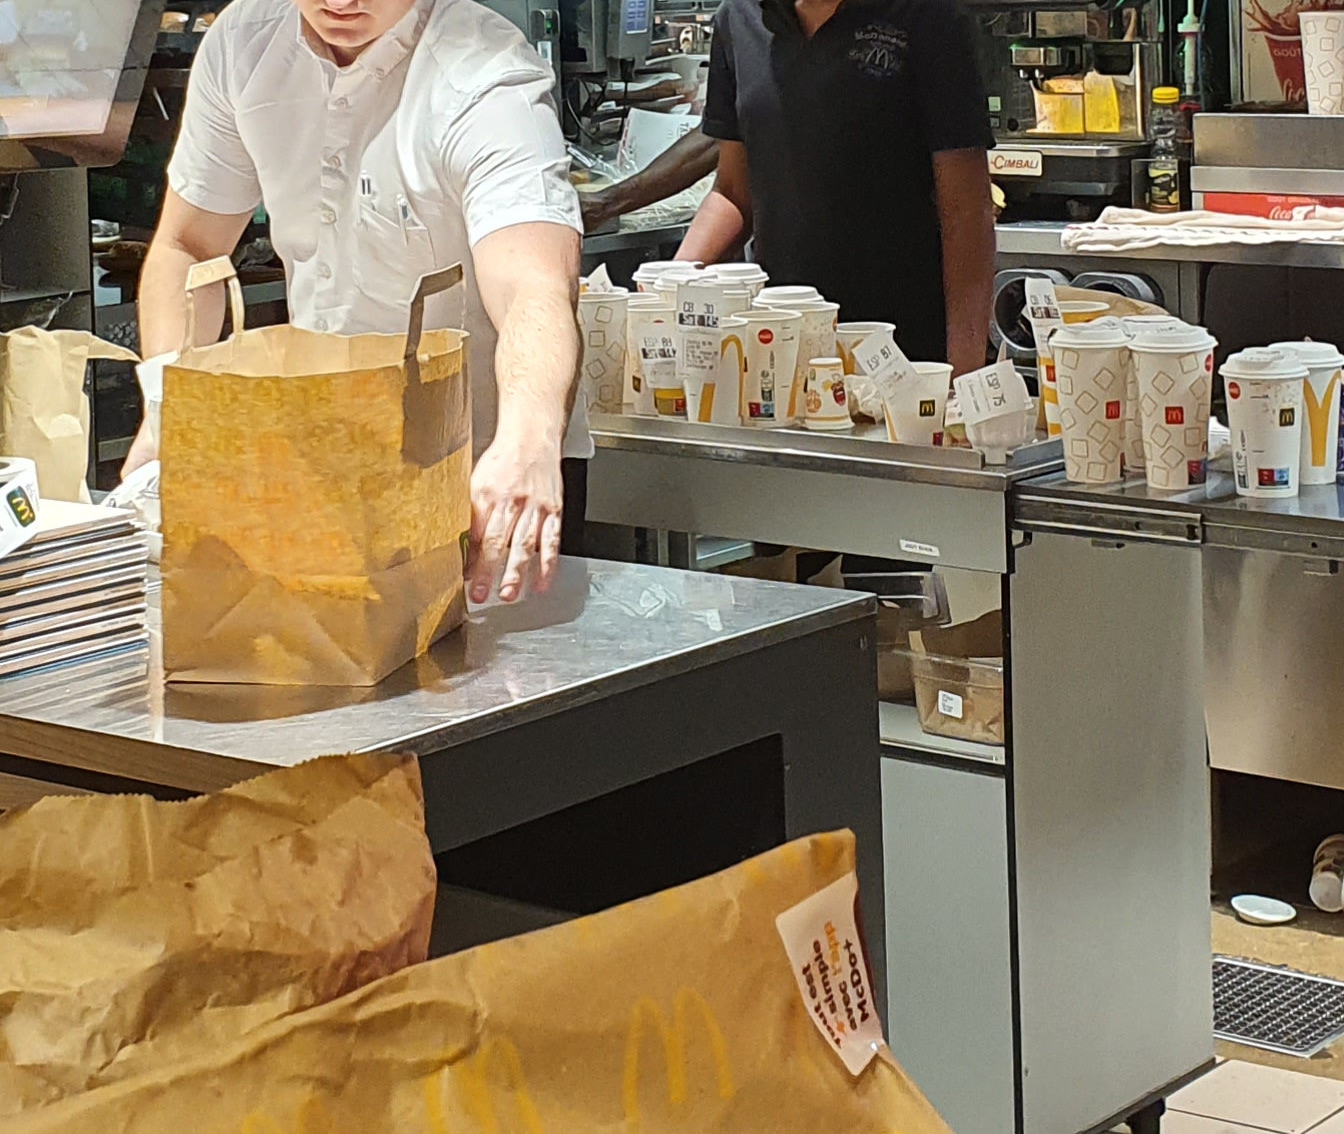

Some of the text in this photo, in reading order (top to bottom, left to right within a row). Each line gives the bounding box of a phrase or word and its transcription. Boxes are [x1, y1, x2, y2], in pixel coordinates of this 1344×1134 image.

[802, 963, 817, 1000] est
[813, 939, 837, 1015] simple
[838, 980, 857, 1031] avec
